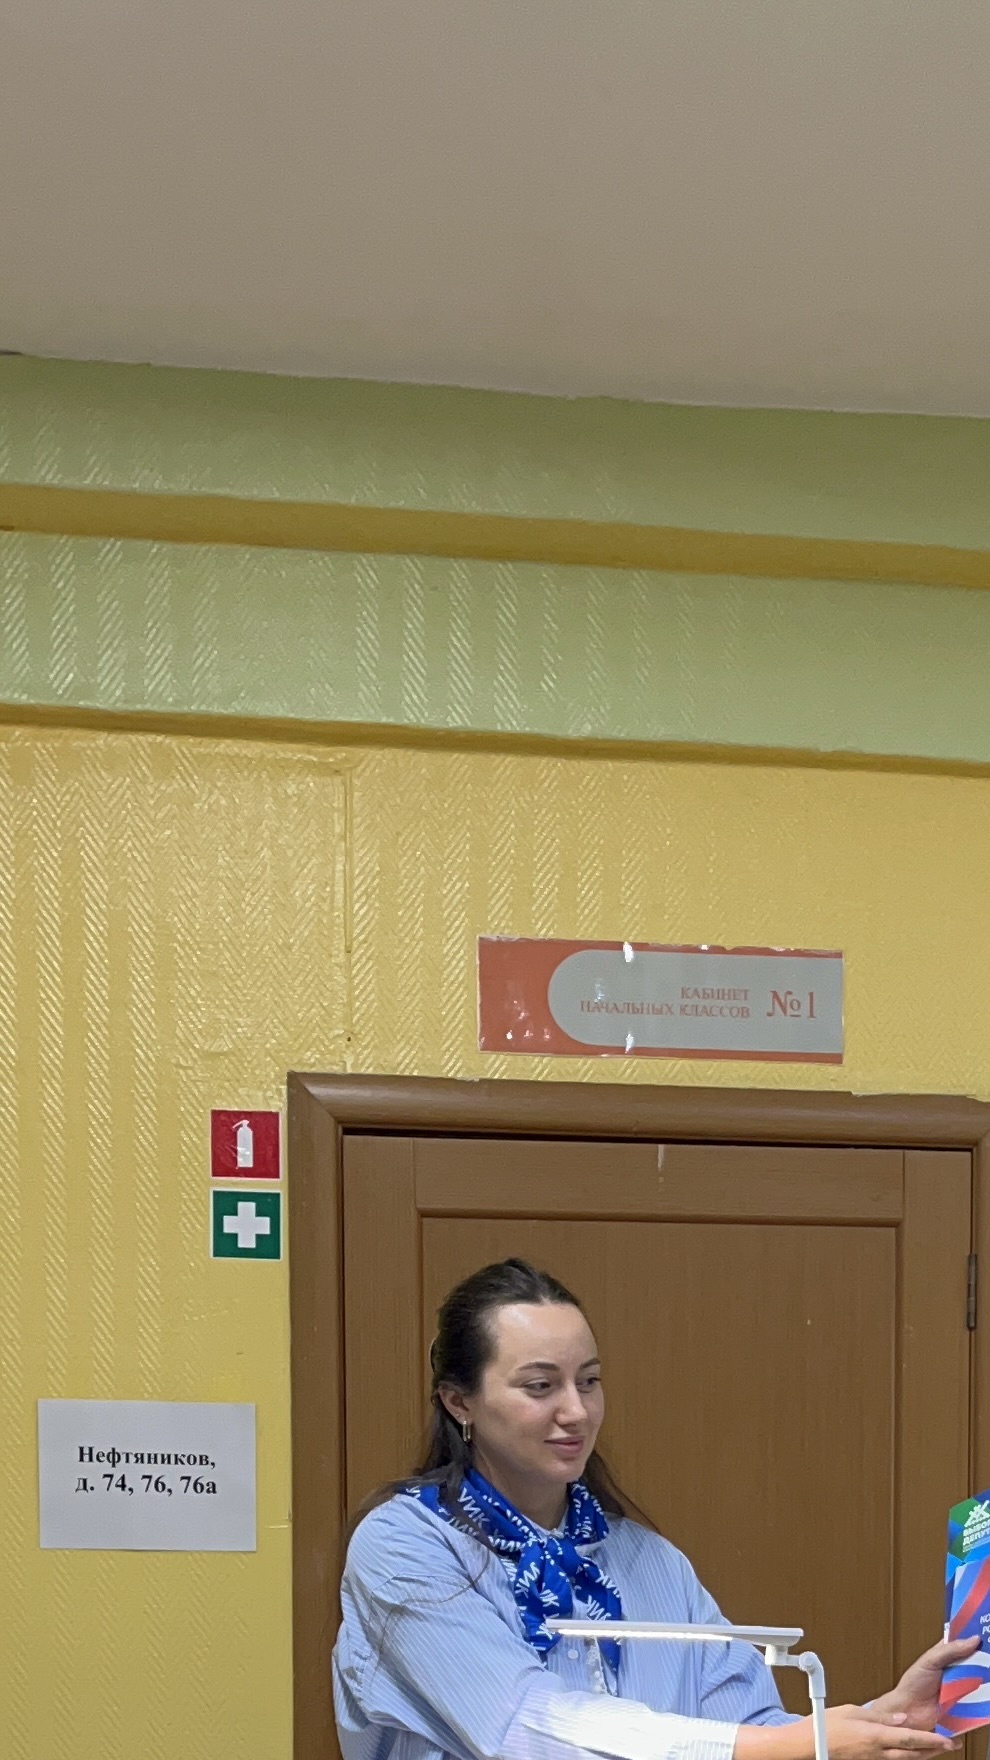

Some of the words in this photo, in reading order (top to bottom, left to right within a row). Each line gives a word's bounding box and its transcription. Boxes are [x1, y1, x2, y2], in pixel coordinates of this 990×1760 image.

[680, 986, 751, 1002] КАБИНЕТ
[580, 1000, 675, 1017] НАЧАЛЬНЫХ
[679, 1005, 751, 1019] КЛАССОВ
[78, 1445, 216, 1469] Нефтяников,
[75, 1477, 96, 1493] д.
[102, 1474, 134, 1496] 74,
[140, 1475, 173, 1496] 76,
[179, 1476, 218, 1495] 76а
